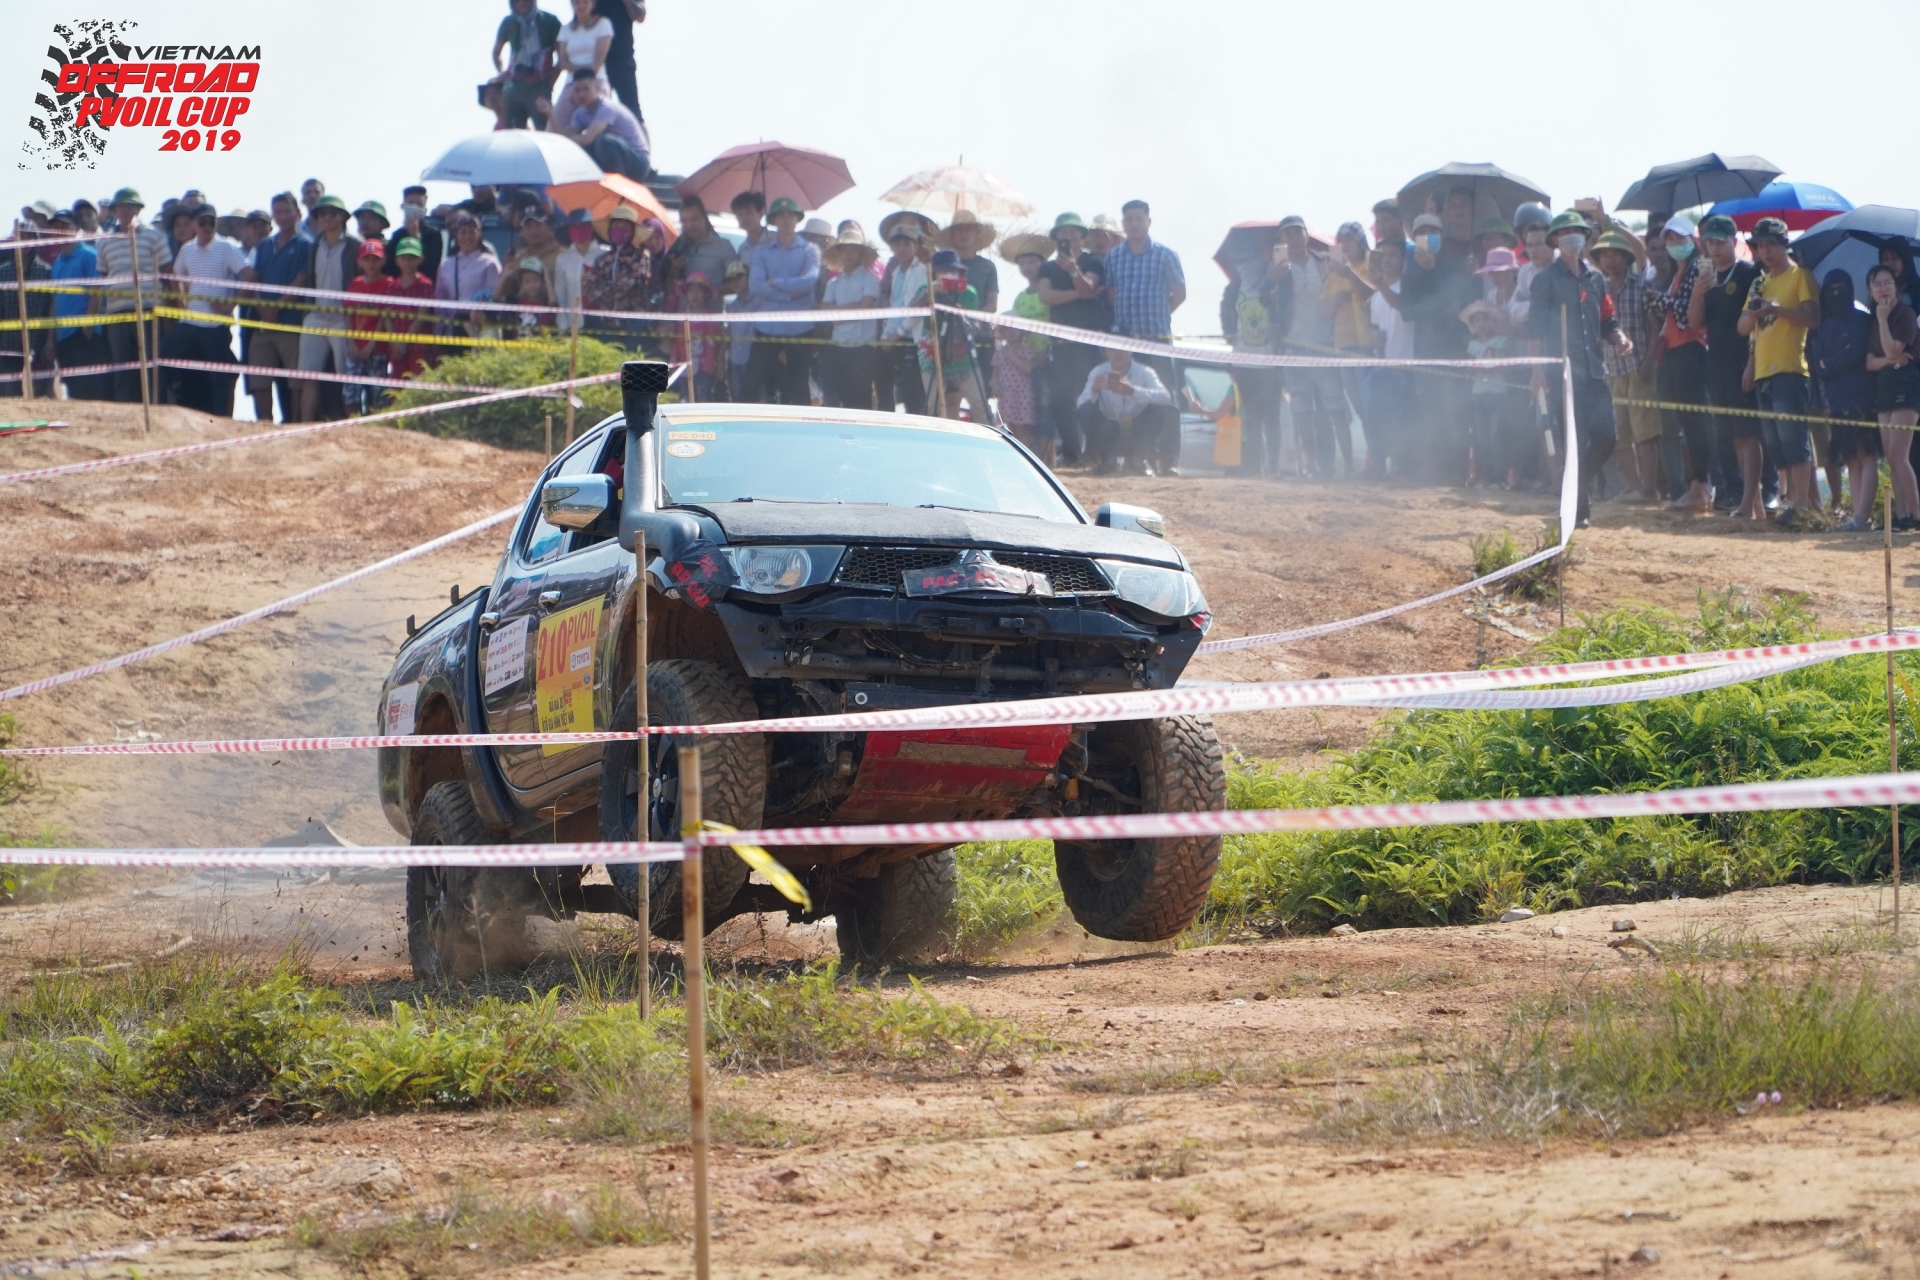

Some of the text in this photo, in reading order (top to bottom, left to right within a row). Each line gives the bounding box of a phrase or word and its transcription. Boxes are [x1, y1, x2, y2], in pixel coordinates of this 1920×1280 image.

[922, 573, 960, 589] PAC
[567, 607, 596, 648] PVOIL
[538, 619, 568, 682] 210
